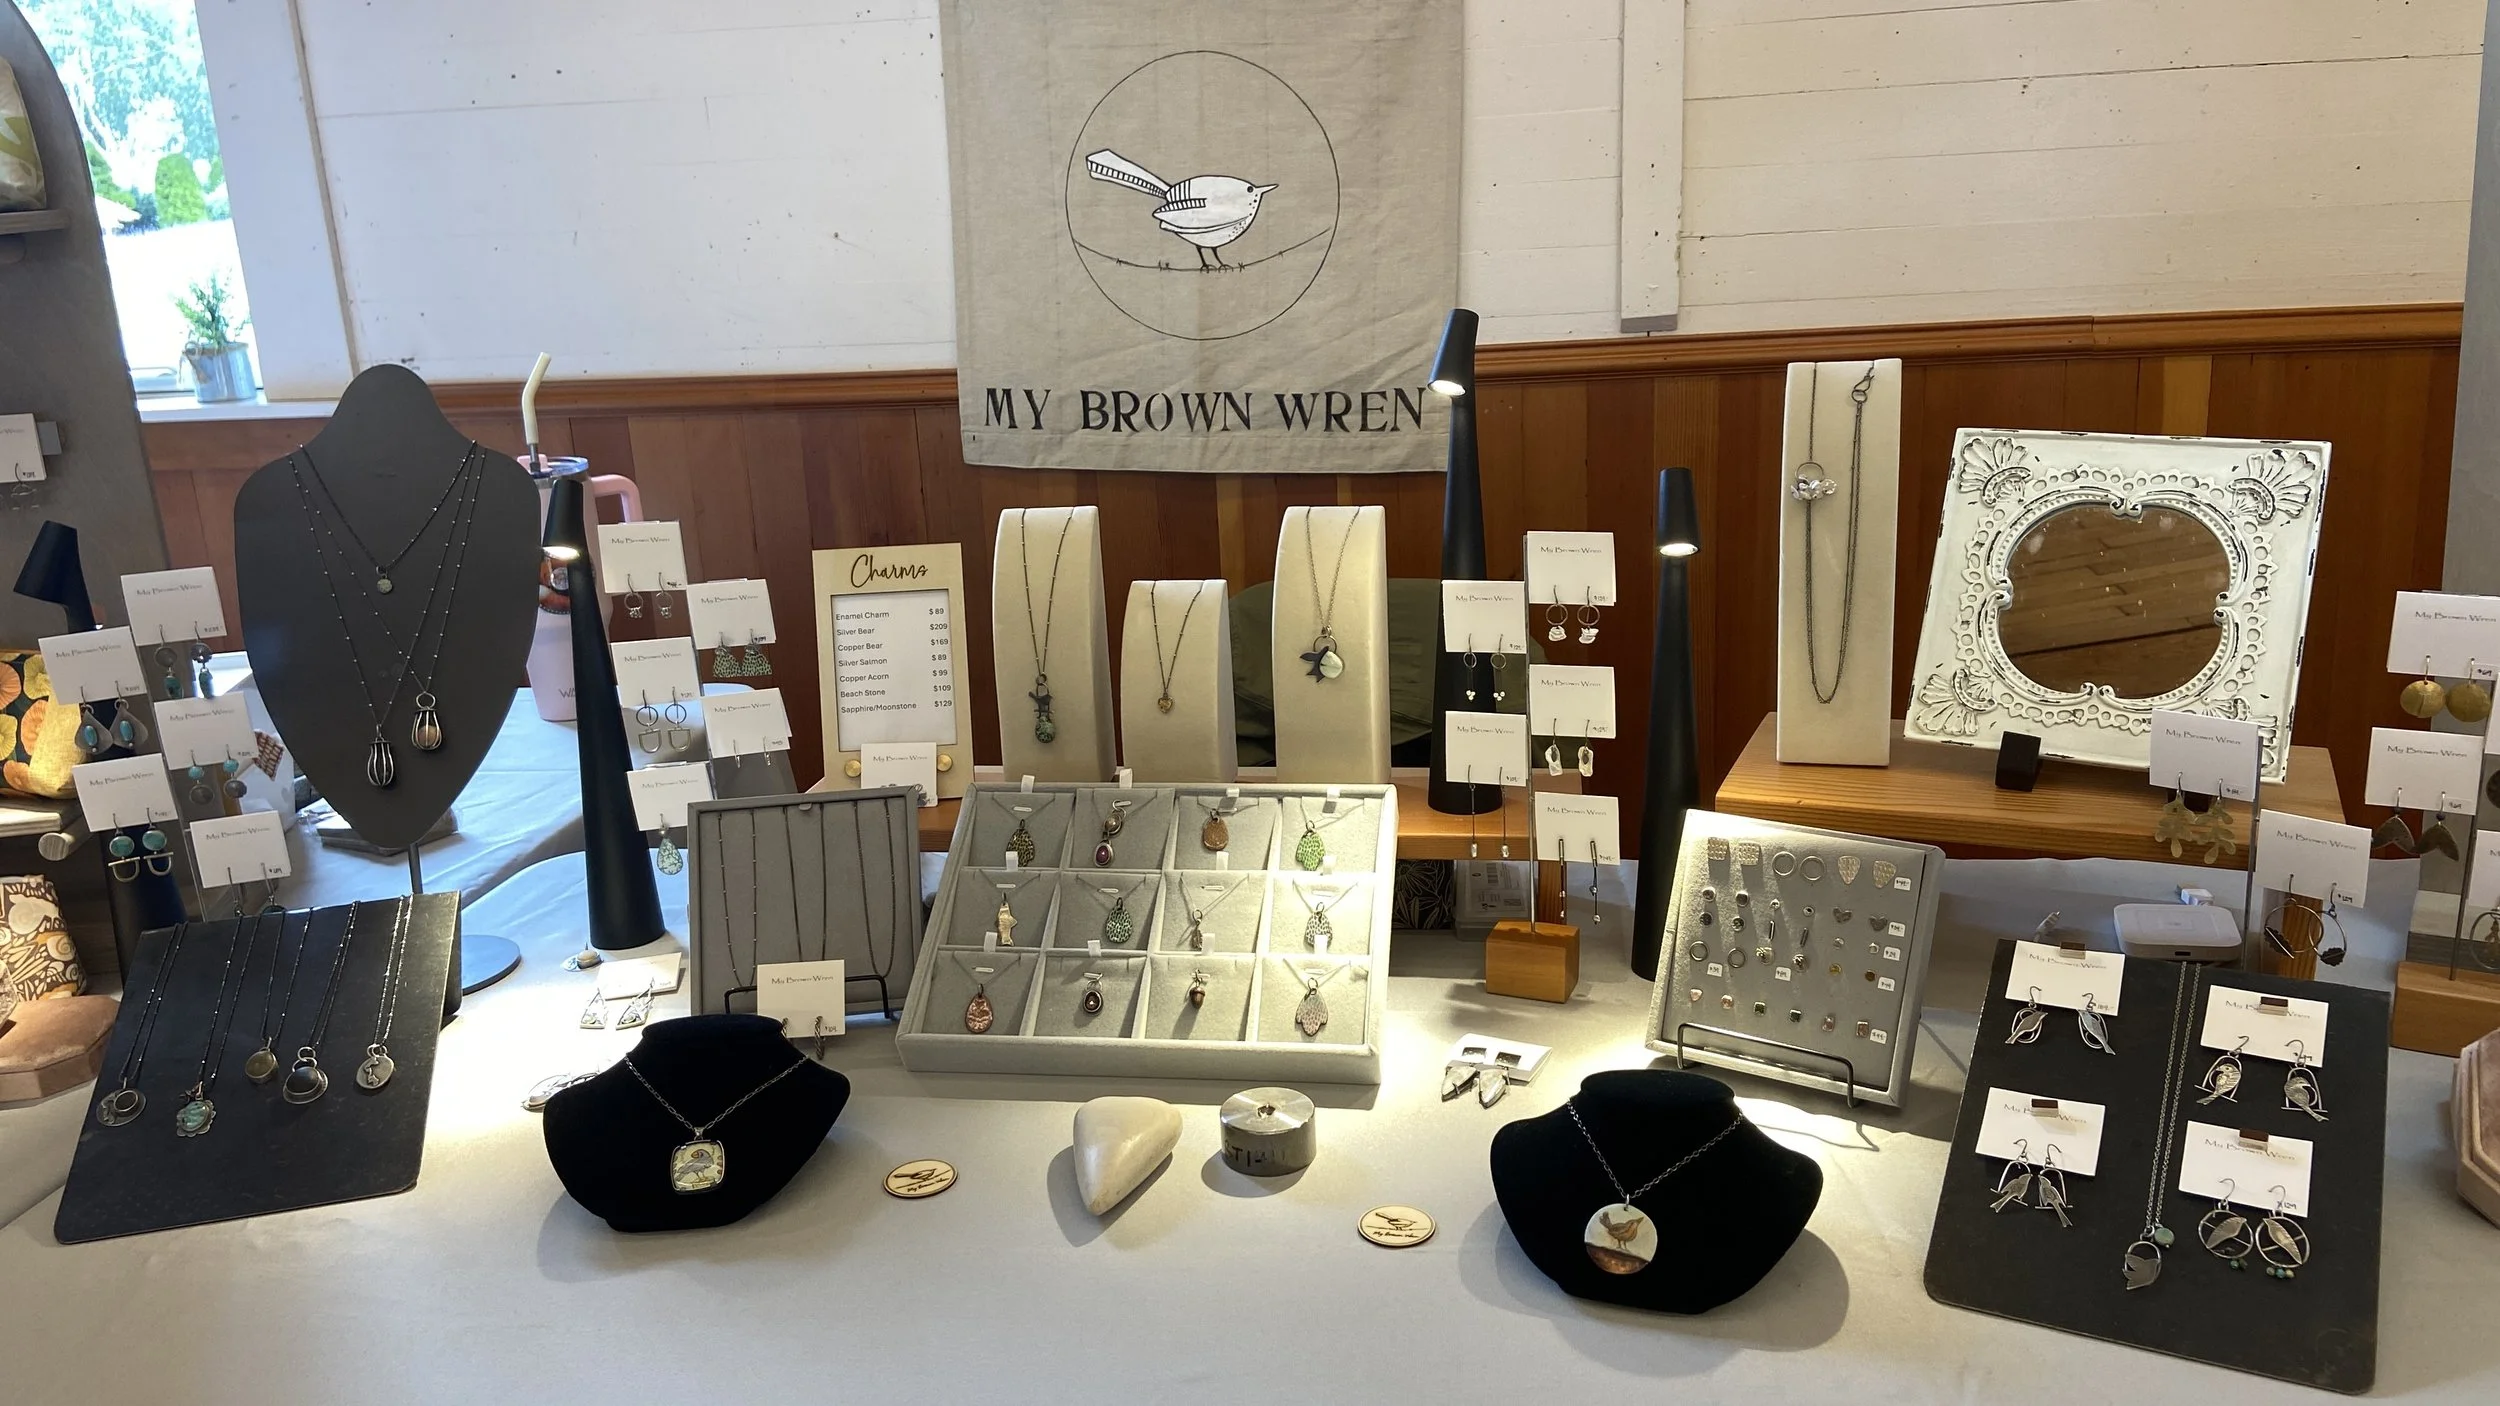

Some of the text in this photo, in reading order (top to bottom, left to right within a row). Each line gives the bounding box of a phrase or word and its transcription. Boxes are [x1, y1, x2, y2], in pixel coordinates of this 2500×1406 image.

[984, 387, 1428, 433] MY BROWN WREN
[850, 554, 929, 588] Charms
[836, 611, 890, 621] Enamel Charm
[836, 627, 875, 636] Silver Bear
[930, 638, 949, 646] $169
[837, 644, 866, 652] Copper
[838, 657, 888, 667] Silver Salmon
[839, 673, 890, 683] Copper Acorn
[840, 690, 863, 698] Beach
[841, 702, 917, 714] Sapphire/Moonstone
[934, 700, 952, 708] $129
[2165, 728, 2182, 738] My
[2387, 745, 2404, 754] My
